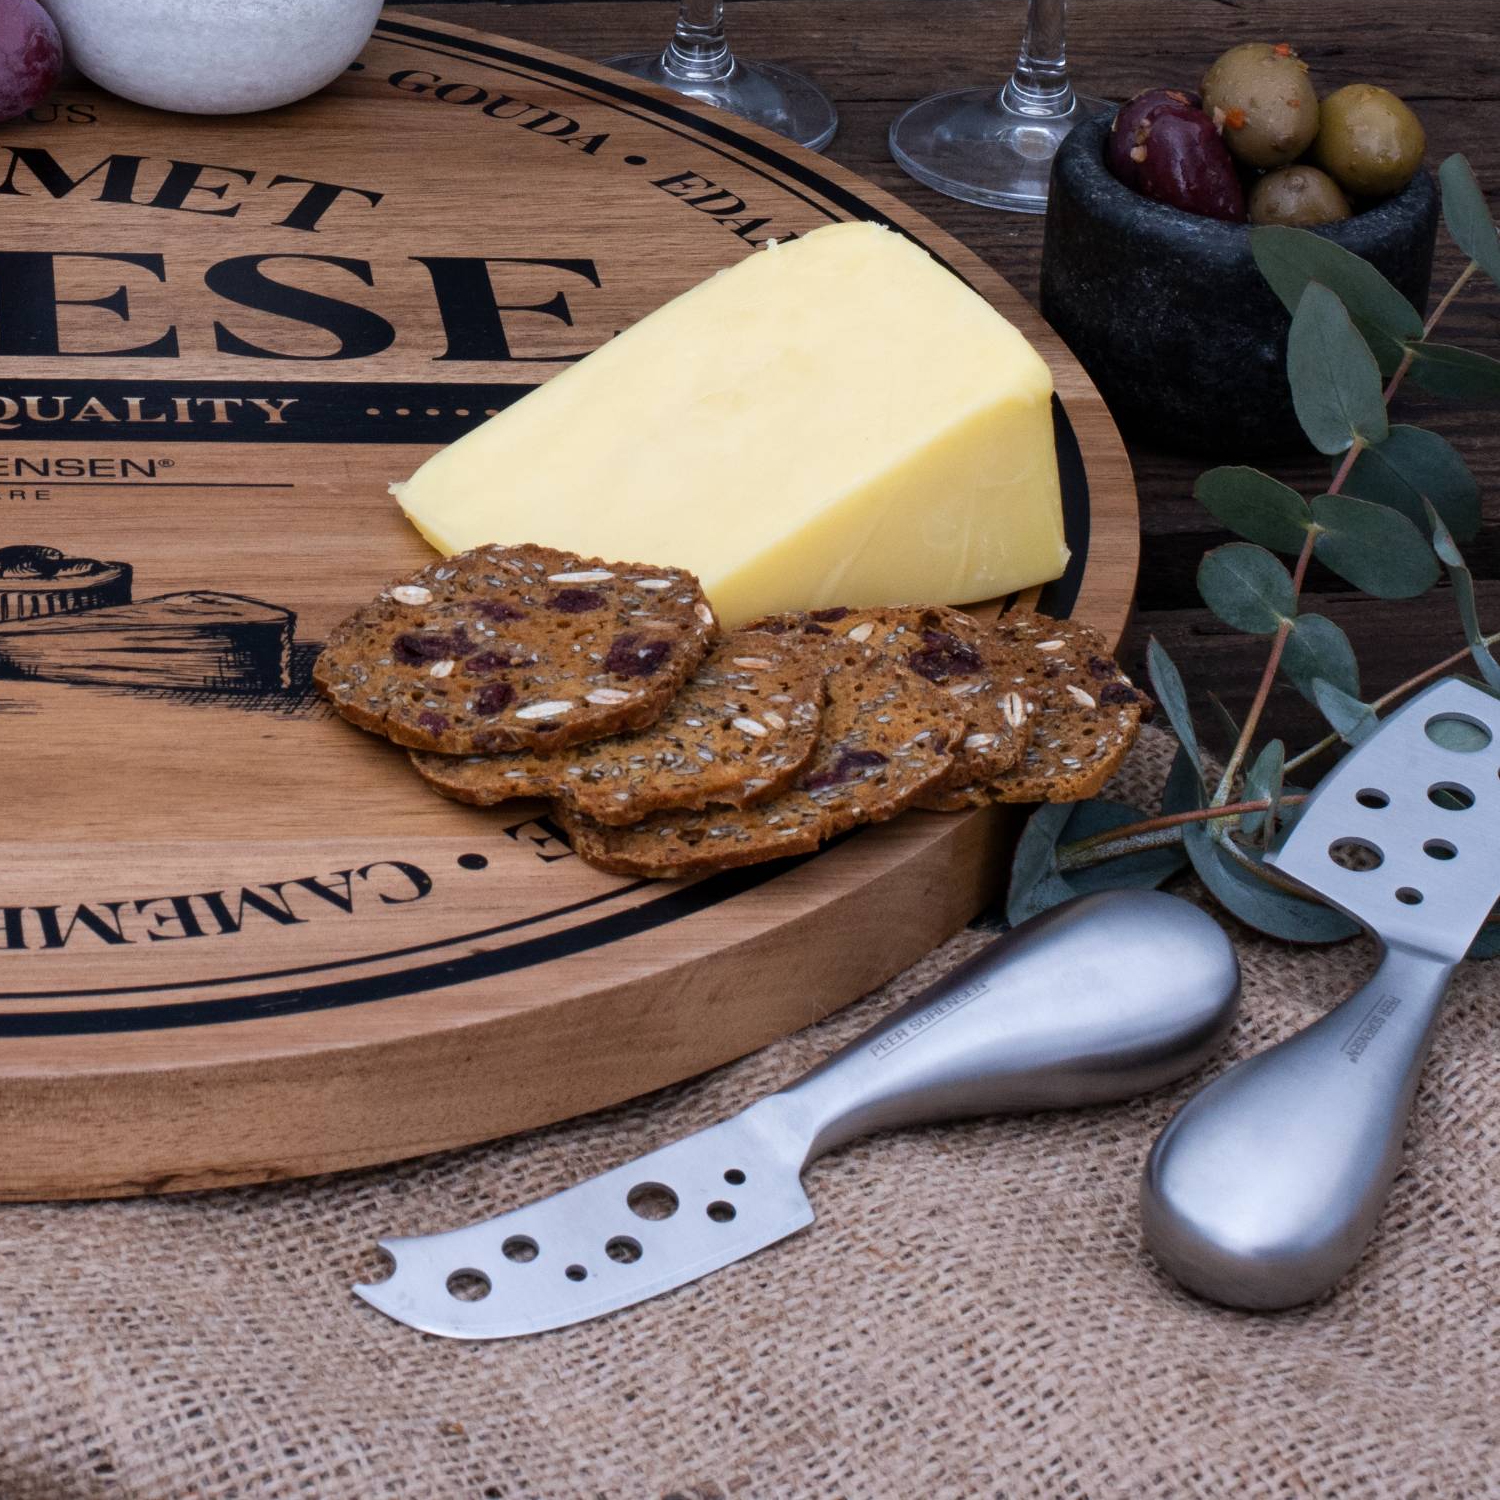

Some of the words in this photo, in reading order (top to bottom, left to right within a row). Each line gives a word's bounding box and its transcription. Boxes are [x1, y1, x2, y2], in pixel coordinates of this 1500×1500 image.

[386, 68, 611, 157] GOUDA
[649, 170, 799, 248] EDA
[869, 1027, 910, 1057] PEER
